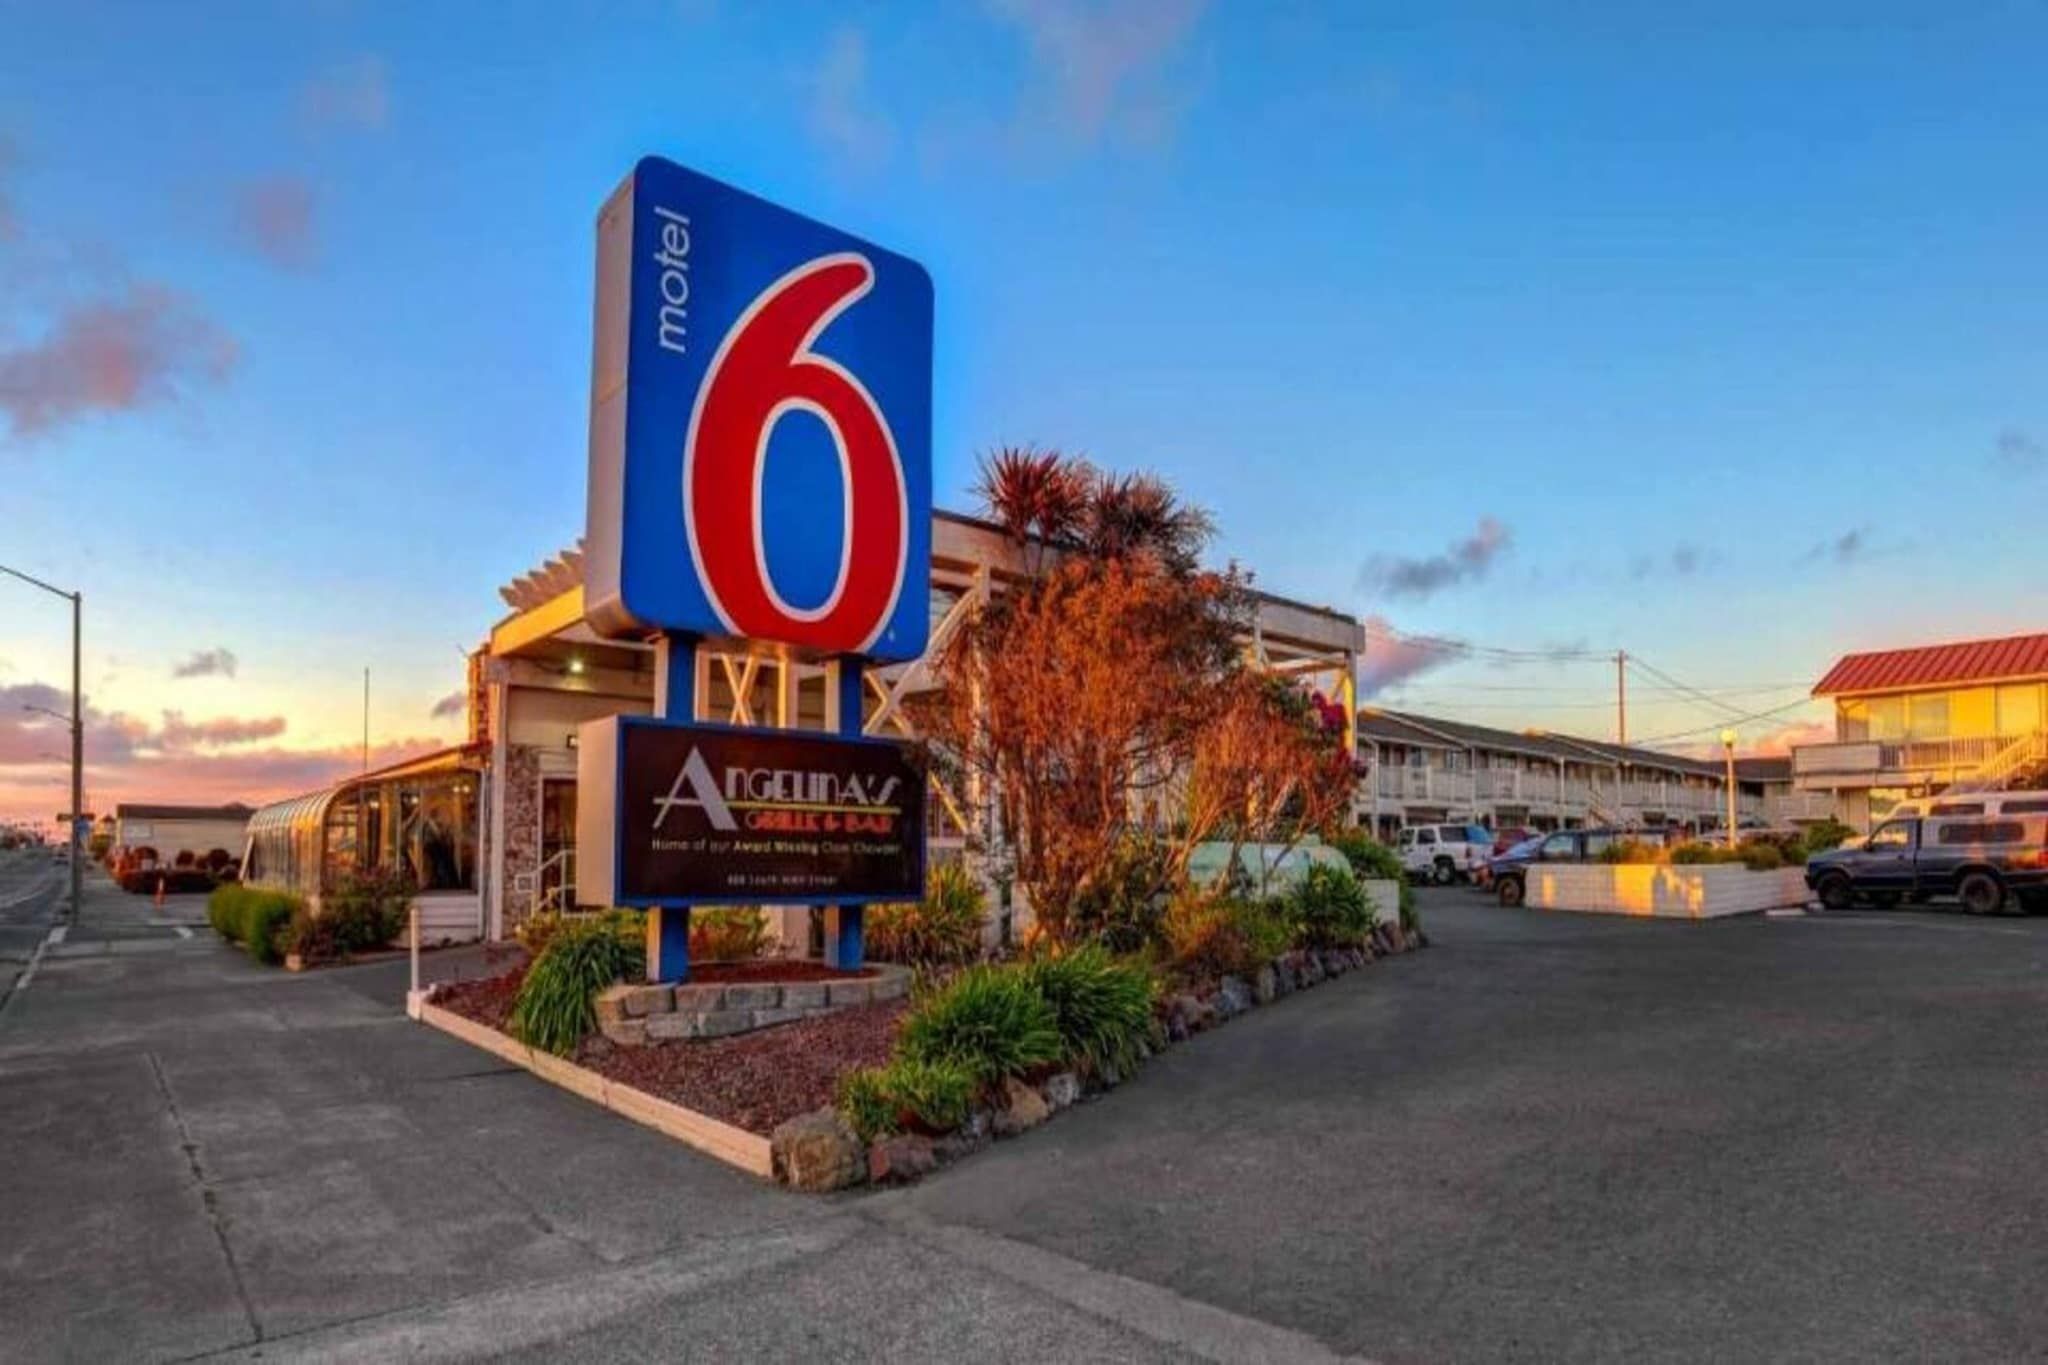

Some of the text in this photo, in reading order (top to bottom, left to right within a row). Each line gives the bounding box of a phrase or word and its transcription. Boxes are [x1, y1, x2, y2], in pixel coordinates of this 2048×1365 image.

[654, 206, 690, 354] motel
[682, 251, 909, 652] 6
[651, 839, 689, 851] Home
[692, 838, 706, 851] of
[733, 840, 772, 853] Award
[844, 813, 893, 833] BAR
